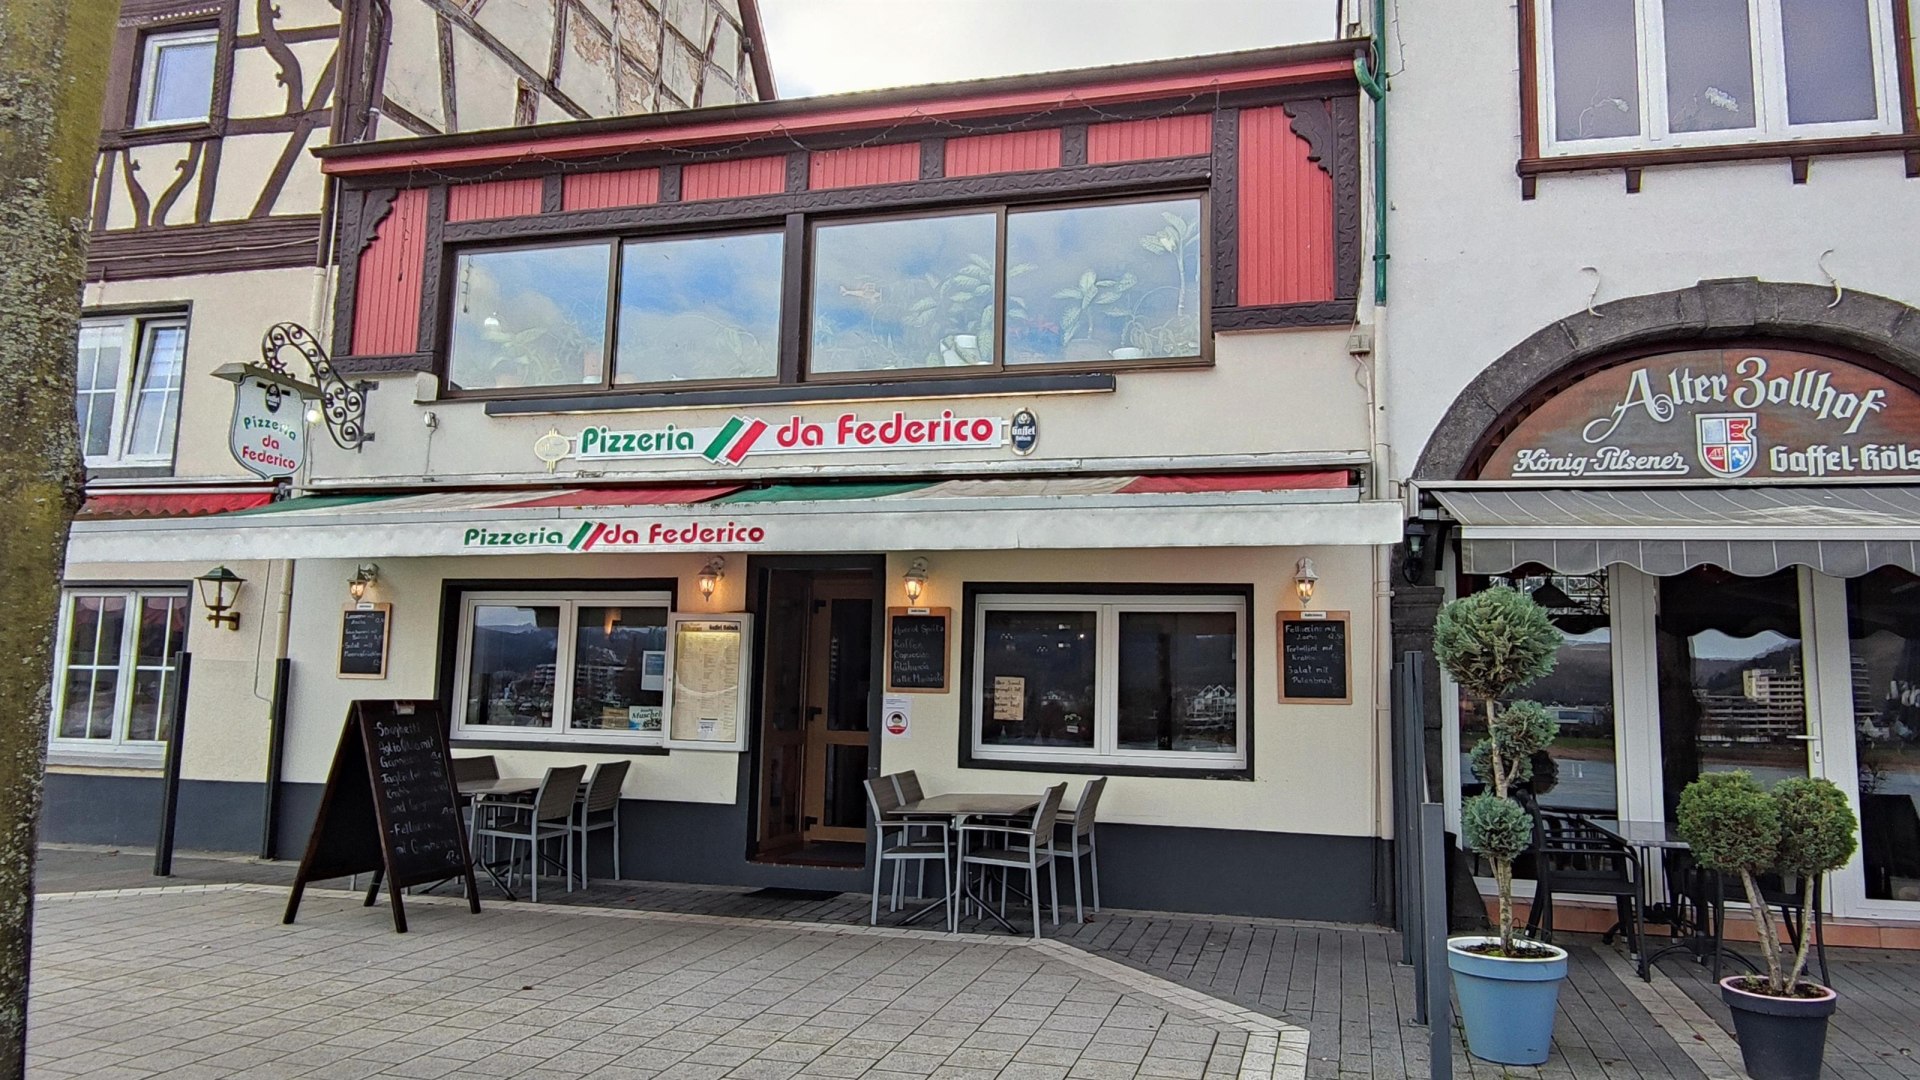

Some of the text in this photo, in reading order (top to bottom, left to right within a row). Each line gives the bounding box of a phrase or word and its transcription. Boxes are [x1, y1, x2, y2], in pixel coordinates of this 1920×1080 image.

[1582, 356, 1887, 444] Alter Zollhof
[261, 434, 280, 450] da
[580, 423, 695, 455] Pizzeria
[776, 415, 825, 448] da
[837, 410, 995, 446] Federico
[241, 445, 296, 470] Federico
[1512, 446, 1690, 477] König-Pilsener
[464, 521, 765, 546] Pizzeria da Federico
